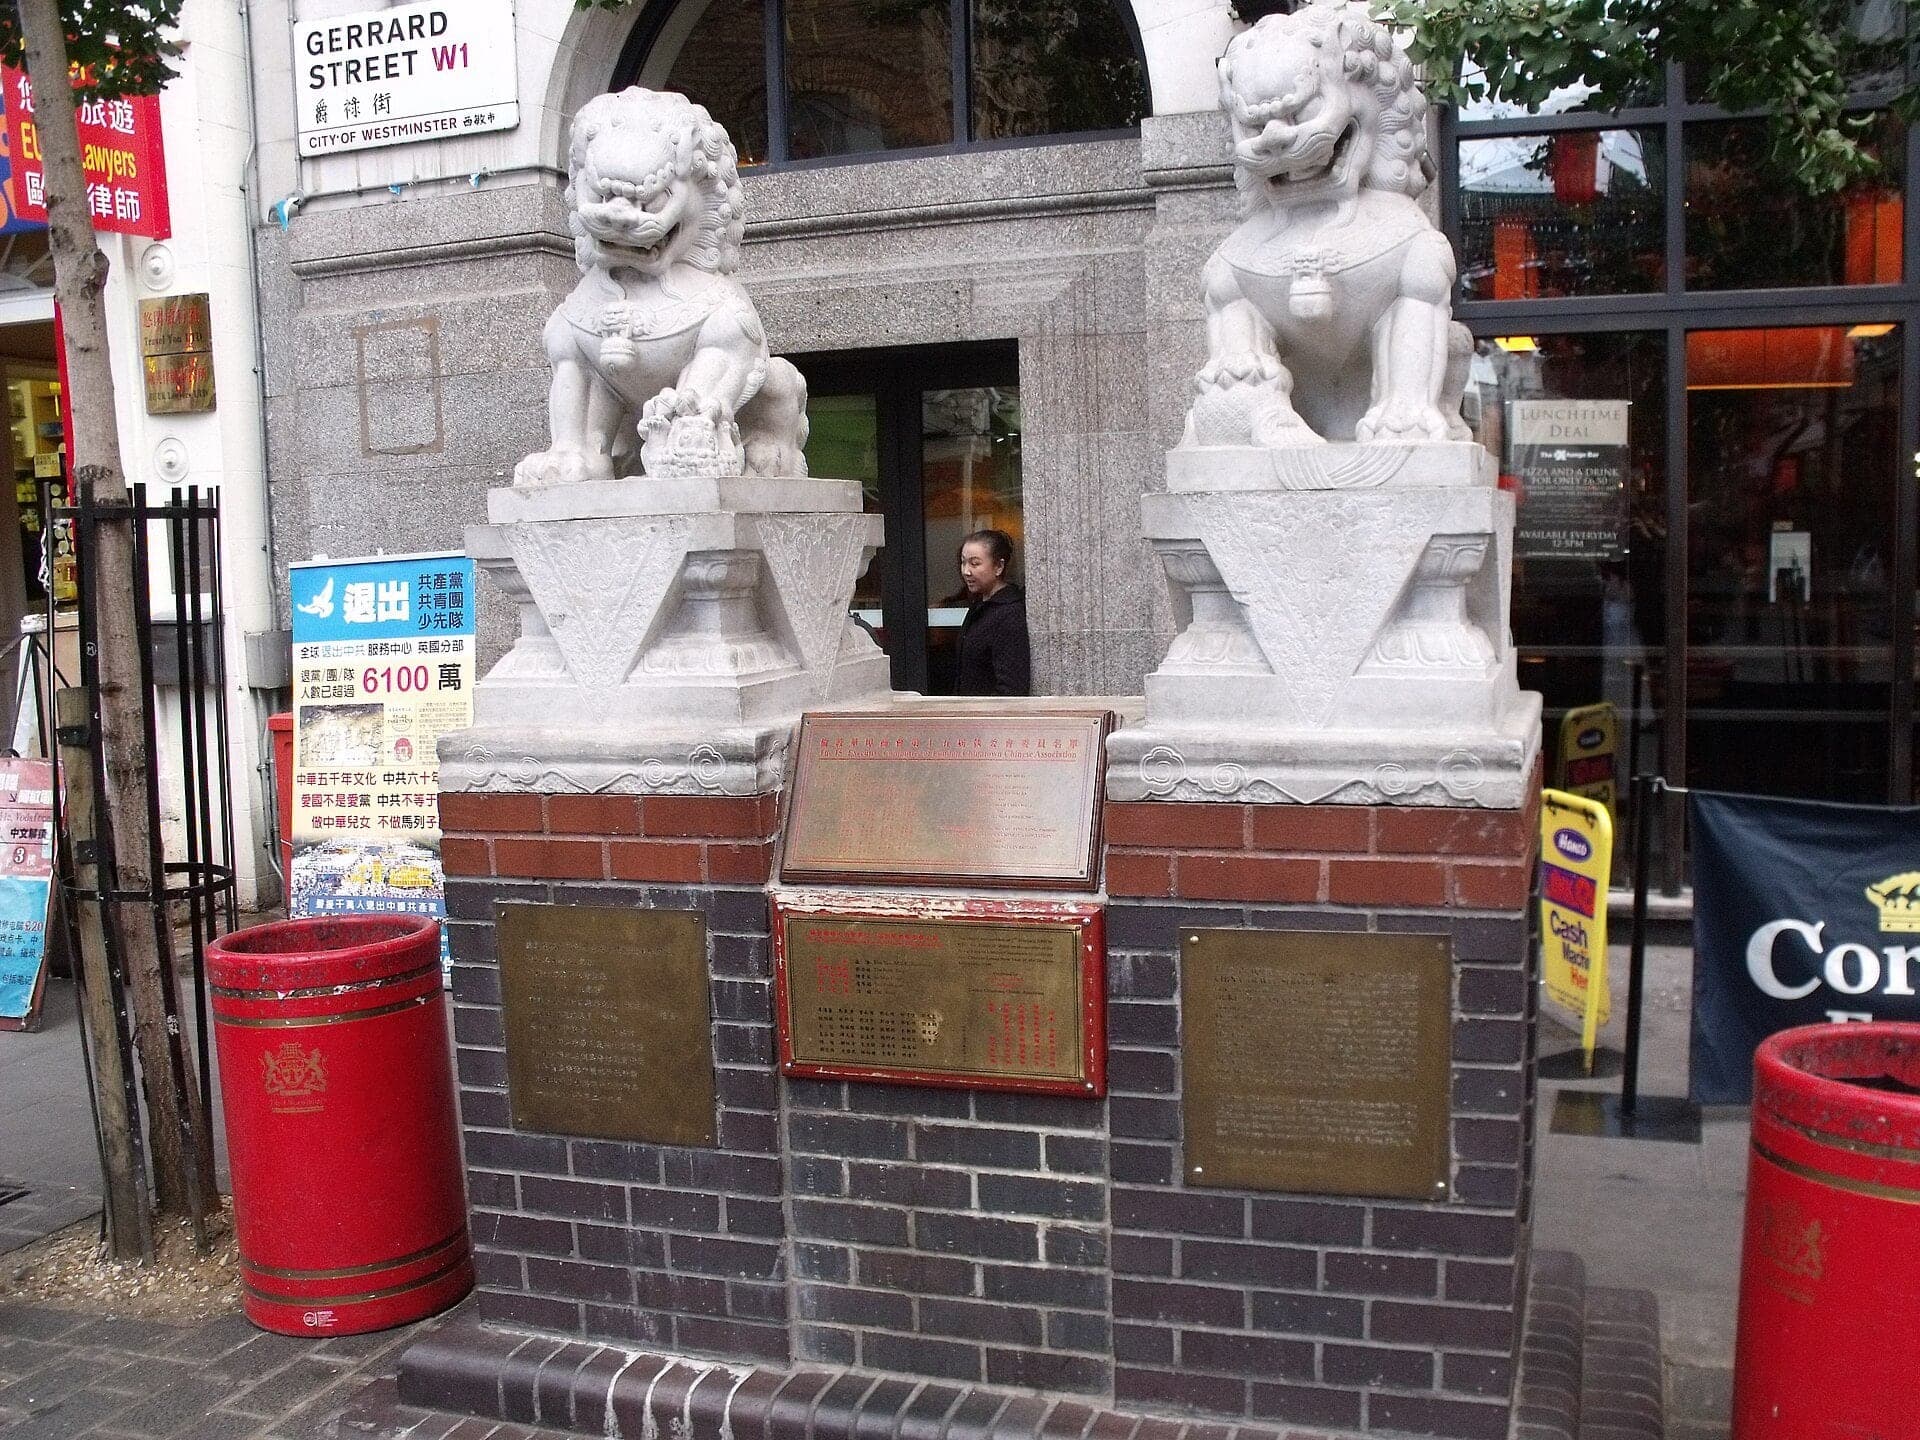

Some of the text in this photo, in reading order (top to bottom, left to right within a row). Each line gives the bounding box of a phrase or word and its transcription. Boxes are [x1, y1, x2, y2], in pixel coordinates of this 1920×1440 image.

[306, 11, 448, 56] GERRARD
[309, 43, 468, 90] STREET W1
[309, 117, 458, 149] CITY OF WESTMINSTER
[82, 143, 138, 182] awyers
[86, 182, 140, 222] 律師
[1519, 407, 1622, 421] LUNCHTIME
[1550, 424, 1589, 438] DEAL
[1519, 530, 1618, 541] AVAILABLE EVERYDAY
[418, 571, 464, 591] 共產黨
[343, 579, 411, 624] 退出
[418, 591, 464, 611] 共青團
[418, 611, 464, 630] 少先隊
[363, 663, 462, 694] 6100 萬
[296, 771, 377, 786] 中華五千年文化
[301, 793, 438, 808] 愛國不是愛黨 中共不等于
[311, 815, 371, 829] 做中華兒女
[1550, 910, 1588, 949] Cash
